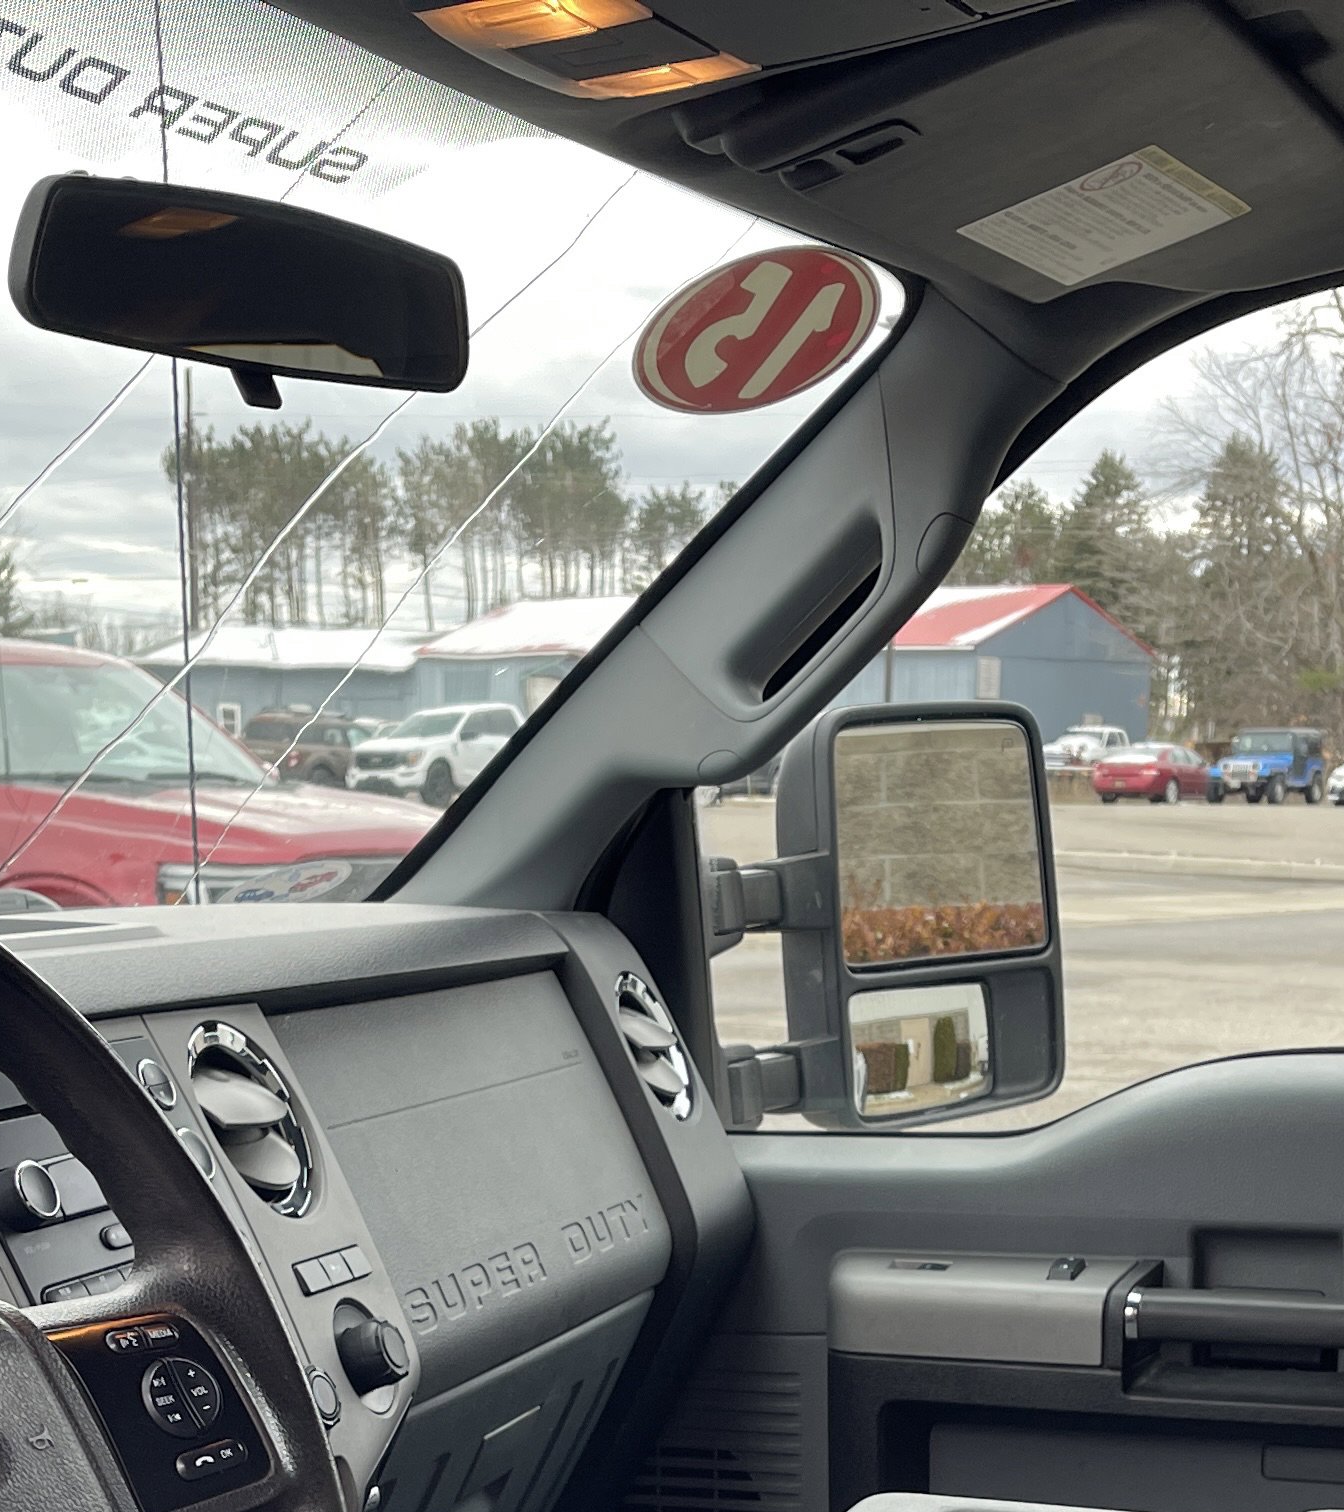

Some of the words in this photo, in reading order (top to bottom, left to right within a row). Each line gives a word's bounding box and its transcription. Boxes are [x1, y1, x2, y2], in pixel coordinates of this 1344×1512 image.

[405, 1241, 547, 1335] SUPER
[561, 1193, 650, 1265] DUTY
[148, 1328, 173, 1339] MEDIA
[190, 1385, 209, 1397] VOL
[155, 1394, 176, 1407] SEEK
[219, 1448, 234, 1459] OK
